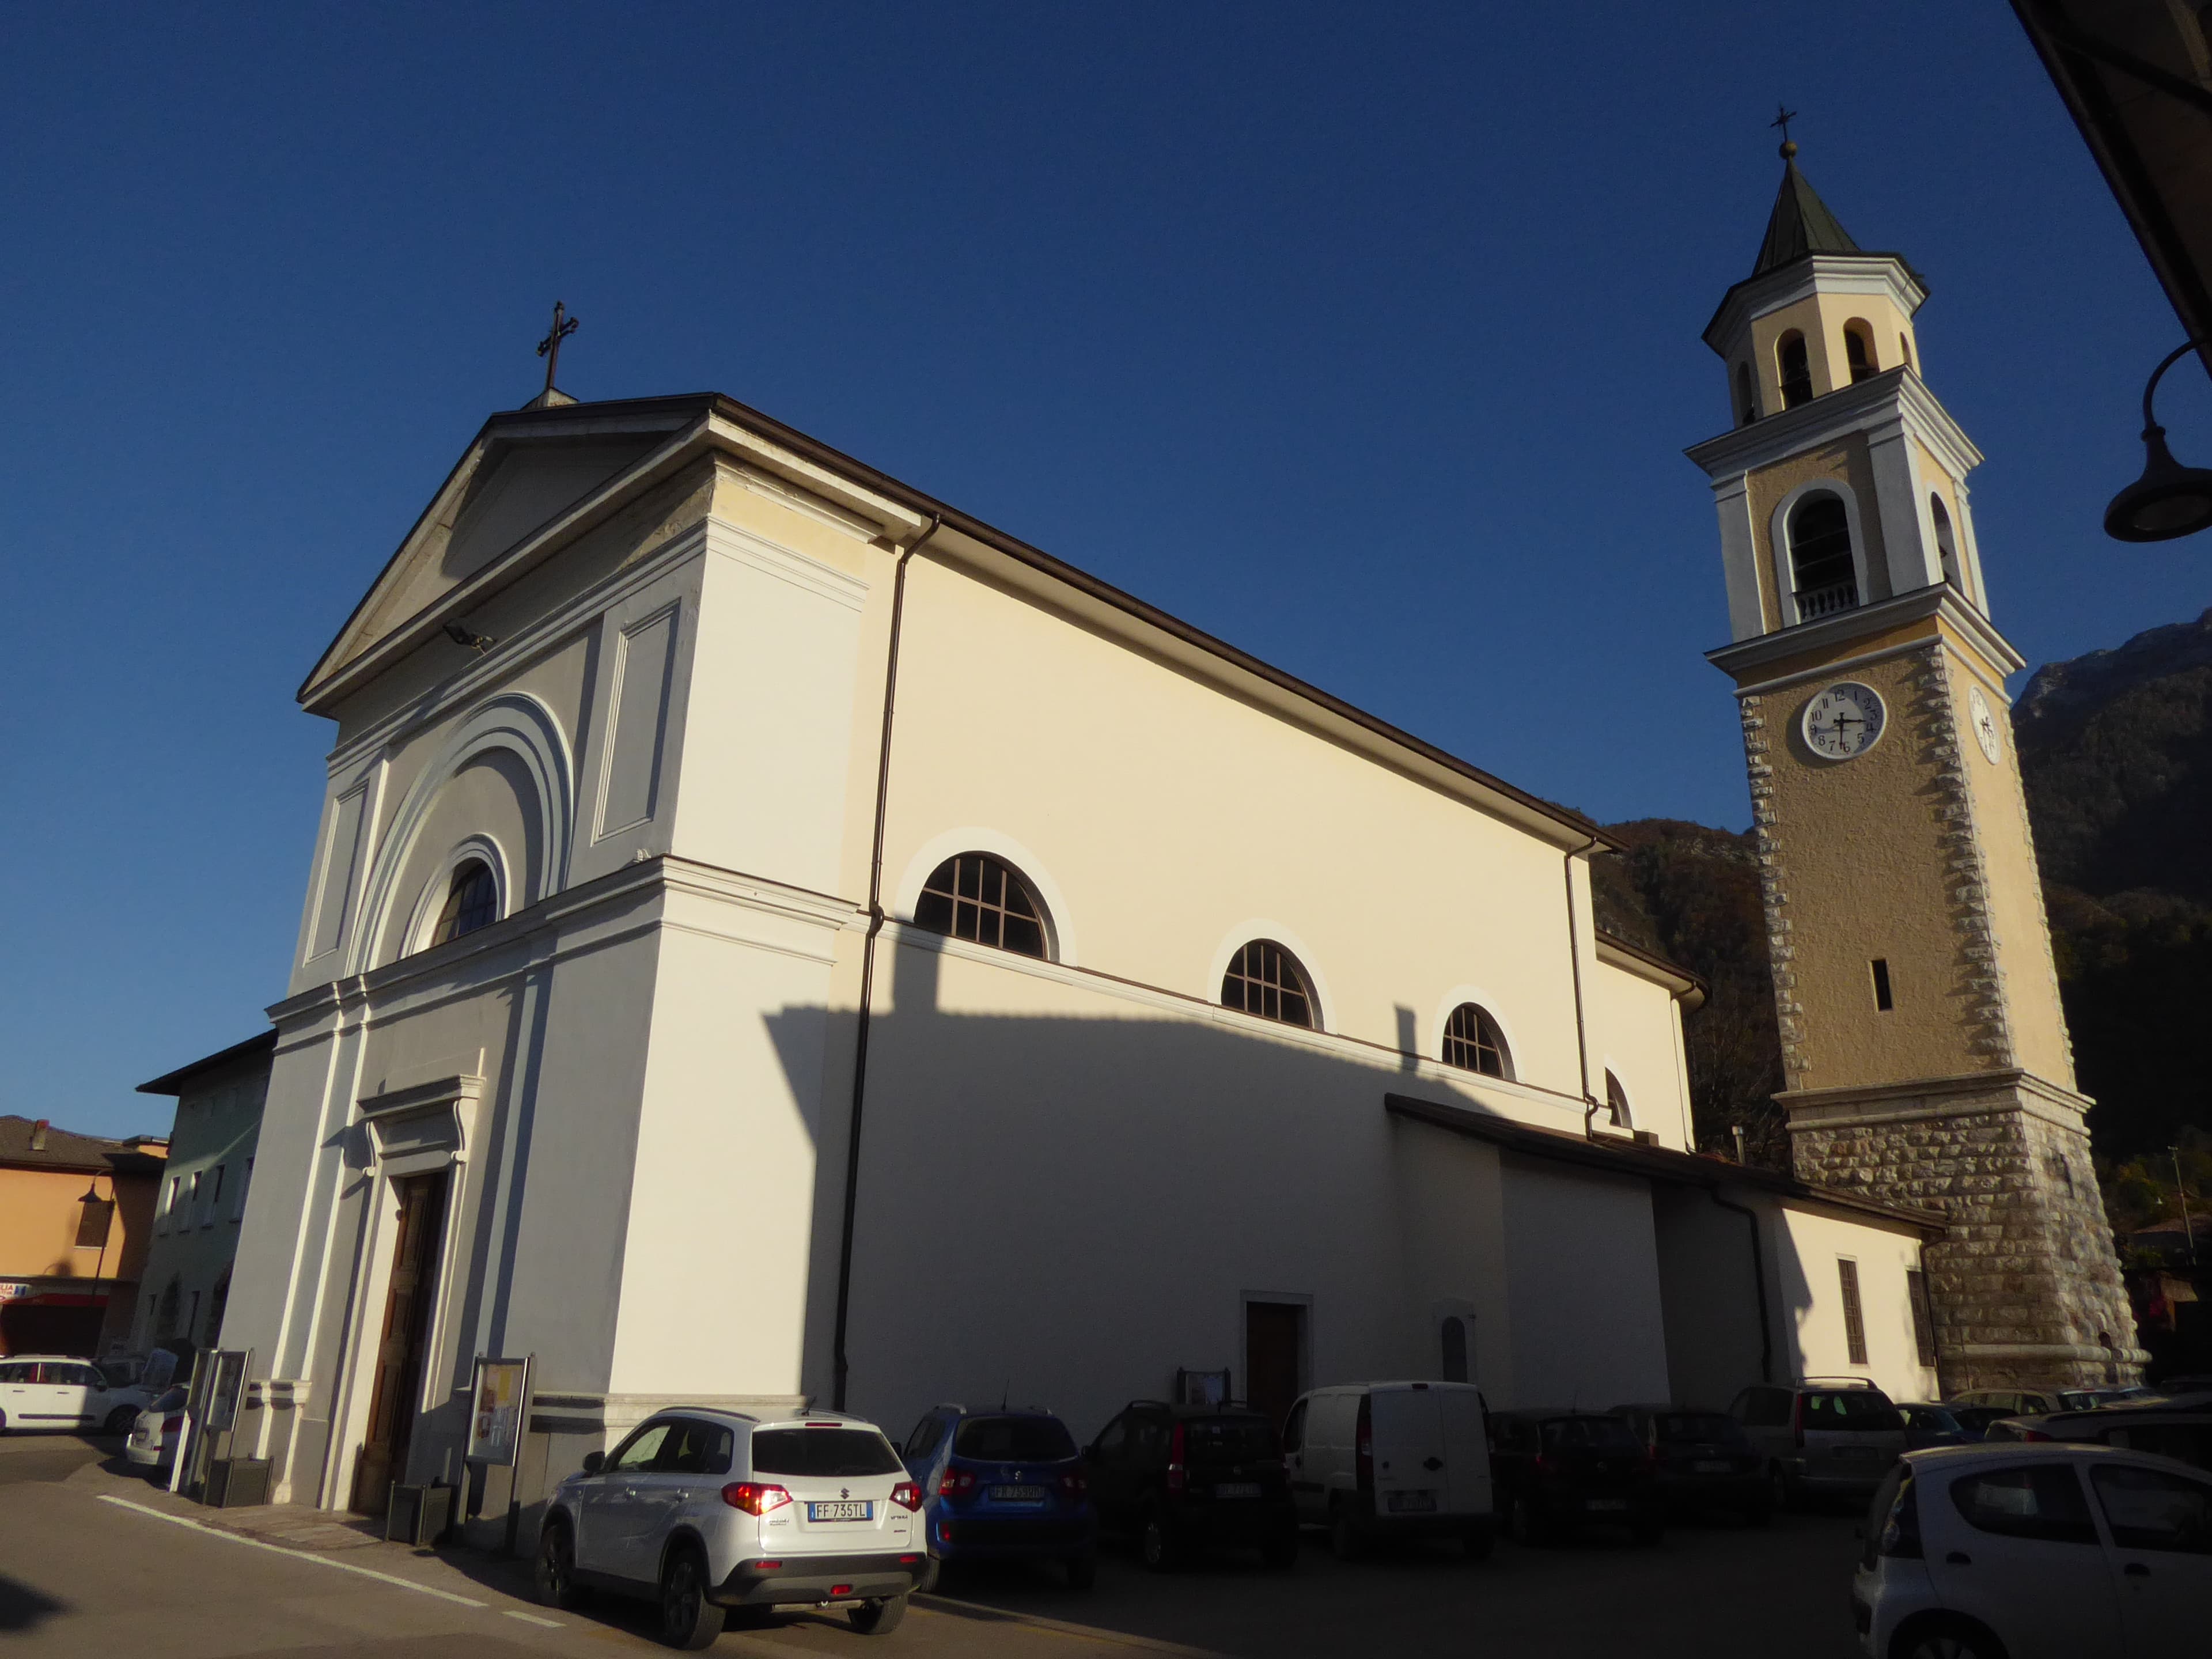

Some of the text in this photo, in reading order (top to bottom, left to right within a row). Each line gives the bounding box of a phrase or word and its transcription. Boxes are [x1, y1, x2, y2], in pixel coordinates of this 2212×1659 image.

[1835, 688, 1845, 702] 12
[1822, 698, 1828, 709] 11
[1863, 698, 1871, 710] 2
[1811, 710, 1821, 721] 10
[1870, 710, 1877, 721] 3
[1810, 724, 1817, 734] 9
[1866, 723, 1874, 733] 4
[1818, 735, 1825, 746] 8
[1857, 733, 1864, 744] 5
[1829, 740, 1835, 751] 7
[1843, 742, 1850, 752] 6
[817, 1505, 829, 1517] FF
